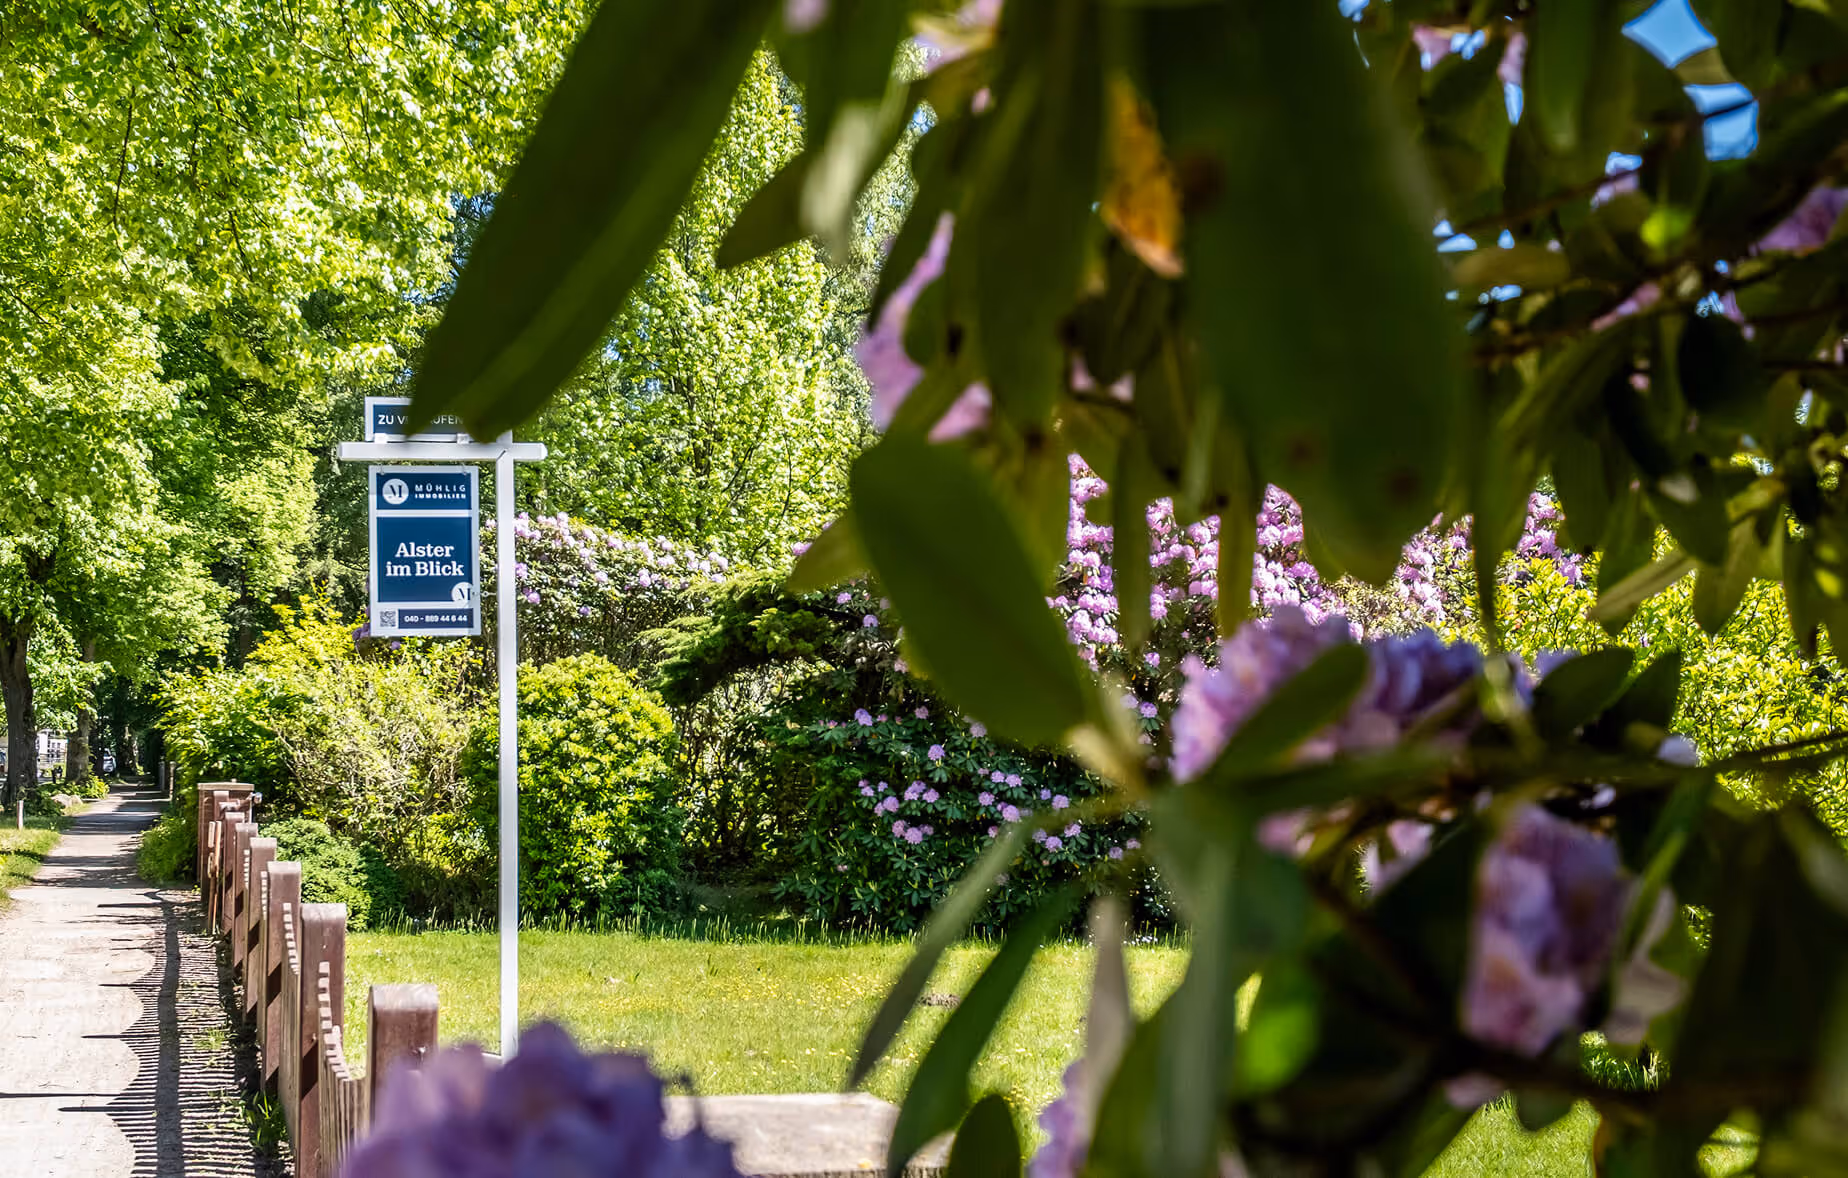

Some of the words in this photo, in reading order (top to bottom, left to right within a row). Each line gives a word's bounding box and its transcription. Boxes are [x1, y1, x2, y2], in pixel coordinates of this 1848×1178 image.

[378, 414, 394, 425] ZU
[397, 415, 464, 425] VUFEN
[415, 483, 466, 492] MÜHLIG
[394, 542, 455, 558] Alster
[385, 561, 412, 577] im
[415, 561, 465, 577] Blick
